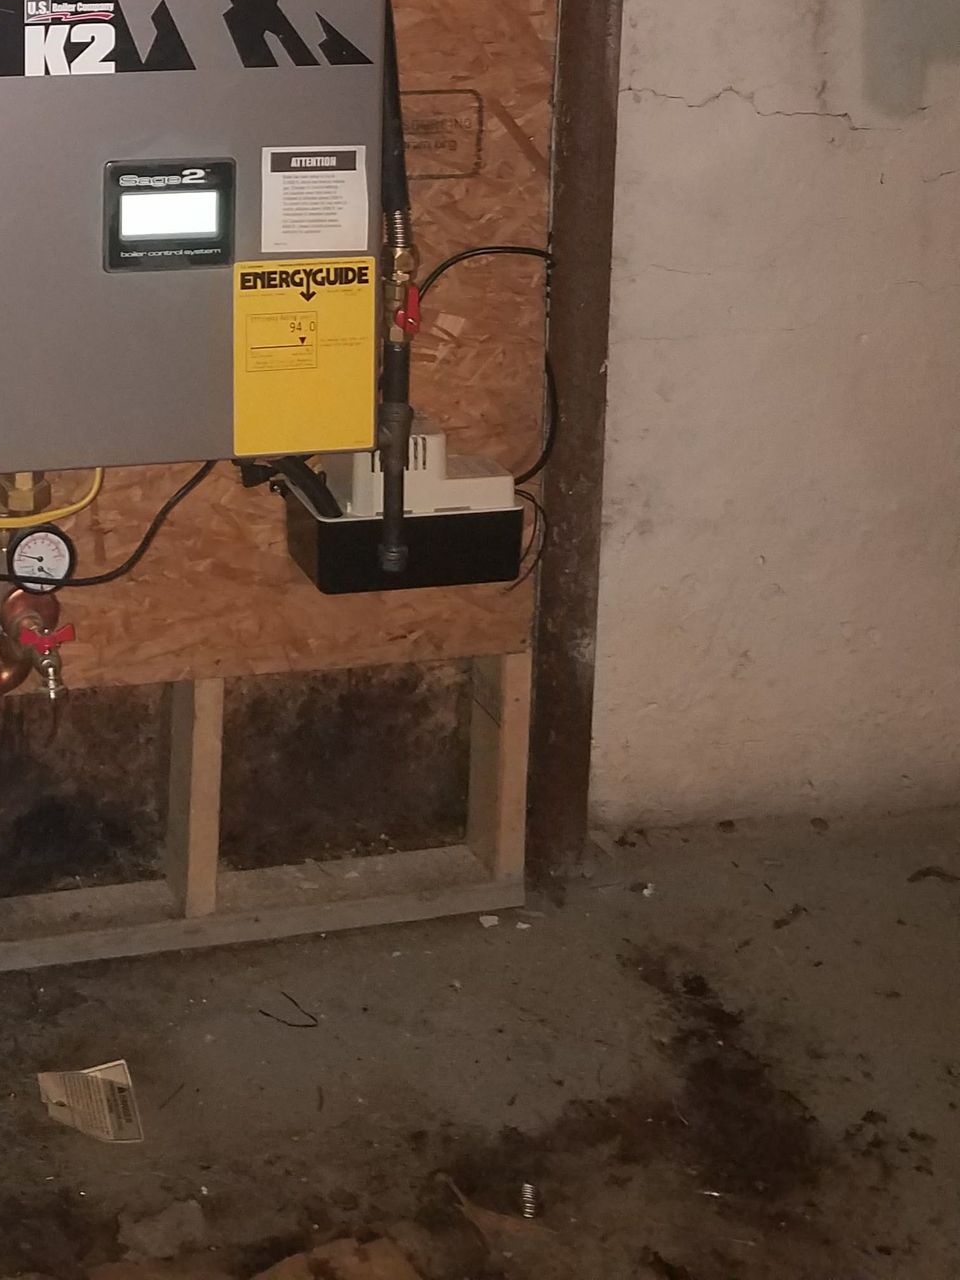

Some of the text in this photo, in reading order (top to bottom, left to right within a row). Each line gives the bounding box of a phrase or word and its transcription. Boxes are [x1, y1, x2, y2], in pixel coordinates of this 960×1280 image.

[27, 1, 49, 15] U.S.
[24, 23, 116, 77] K2
[290, 156, 337, 168] ATTENTION
[120, 248, 222, 258] boiler control system
[240, 266, 370, 291] ENERGYGUIDE
